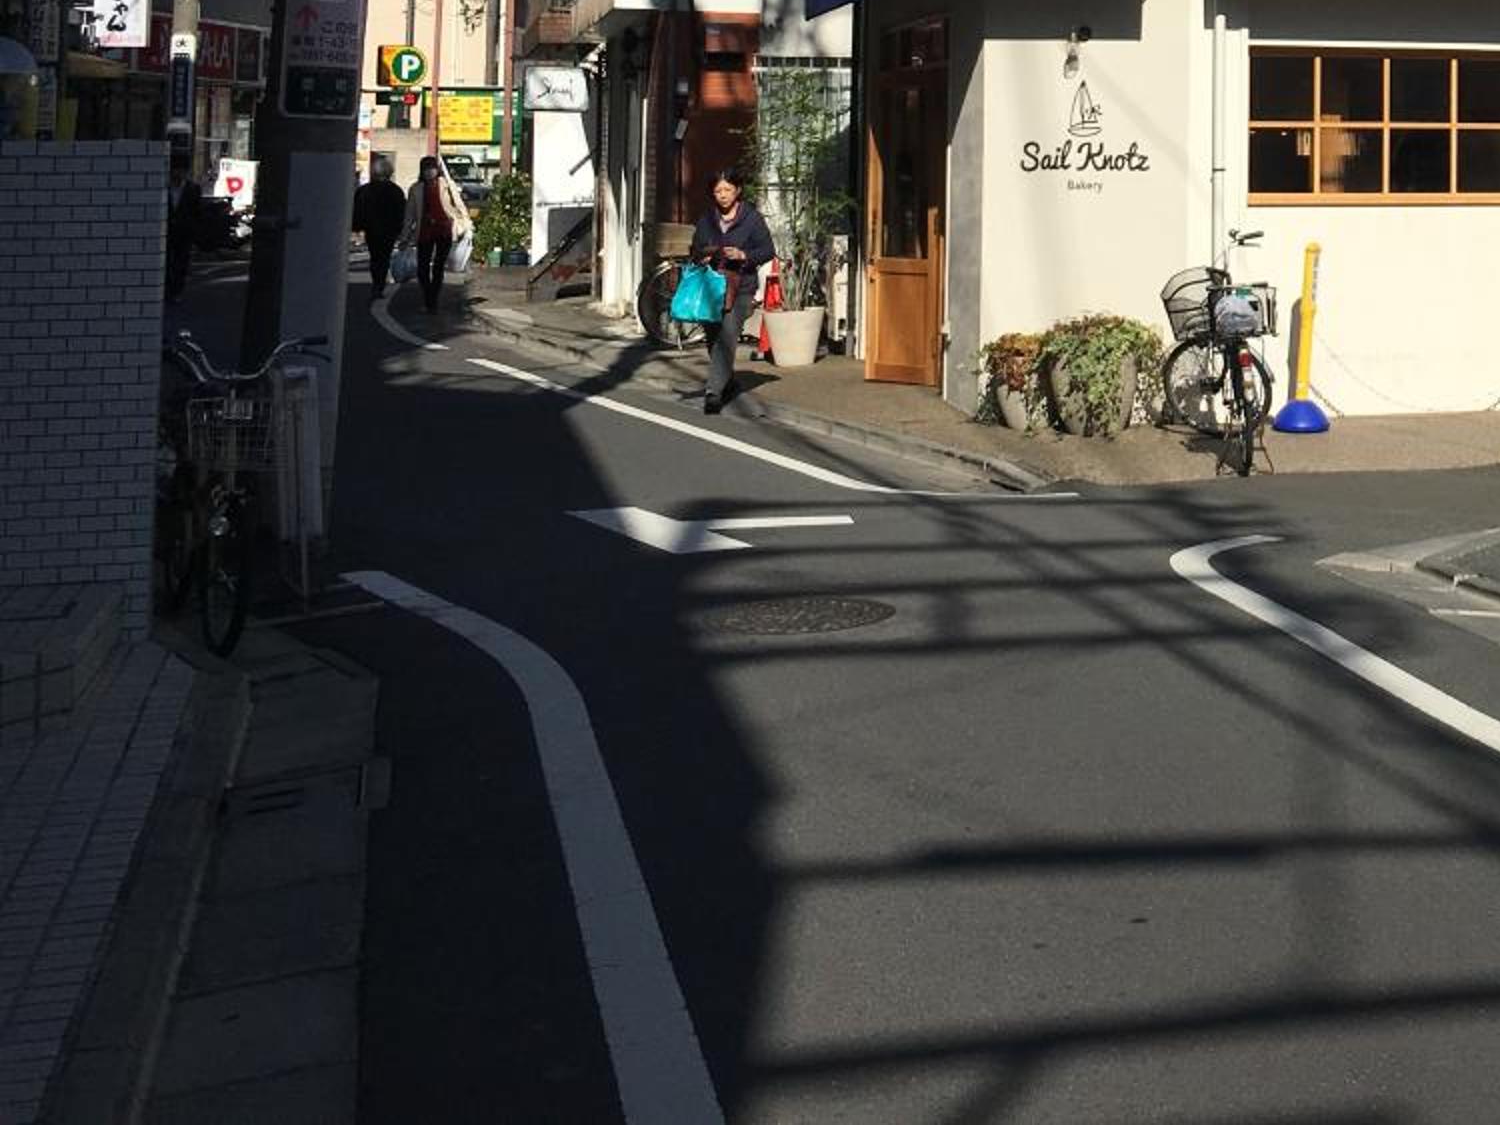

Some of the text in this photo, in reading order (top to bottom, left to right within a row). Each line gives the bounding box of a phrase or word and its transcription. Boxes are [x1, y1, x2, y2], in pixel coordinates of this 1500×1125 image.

[401, 54, 421, 80] P
[1019, 138, 1151, 173] Sail Knotz
[1067, 179, 1104, 194] Bakery
